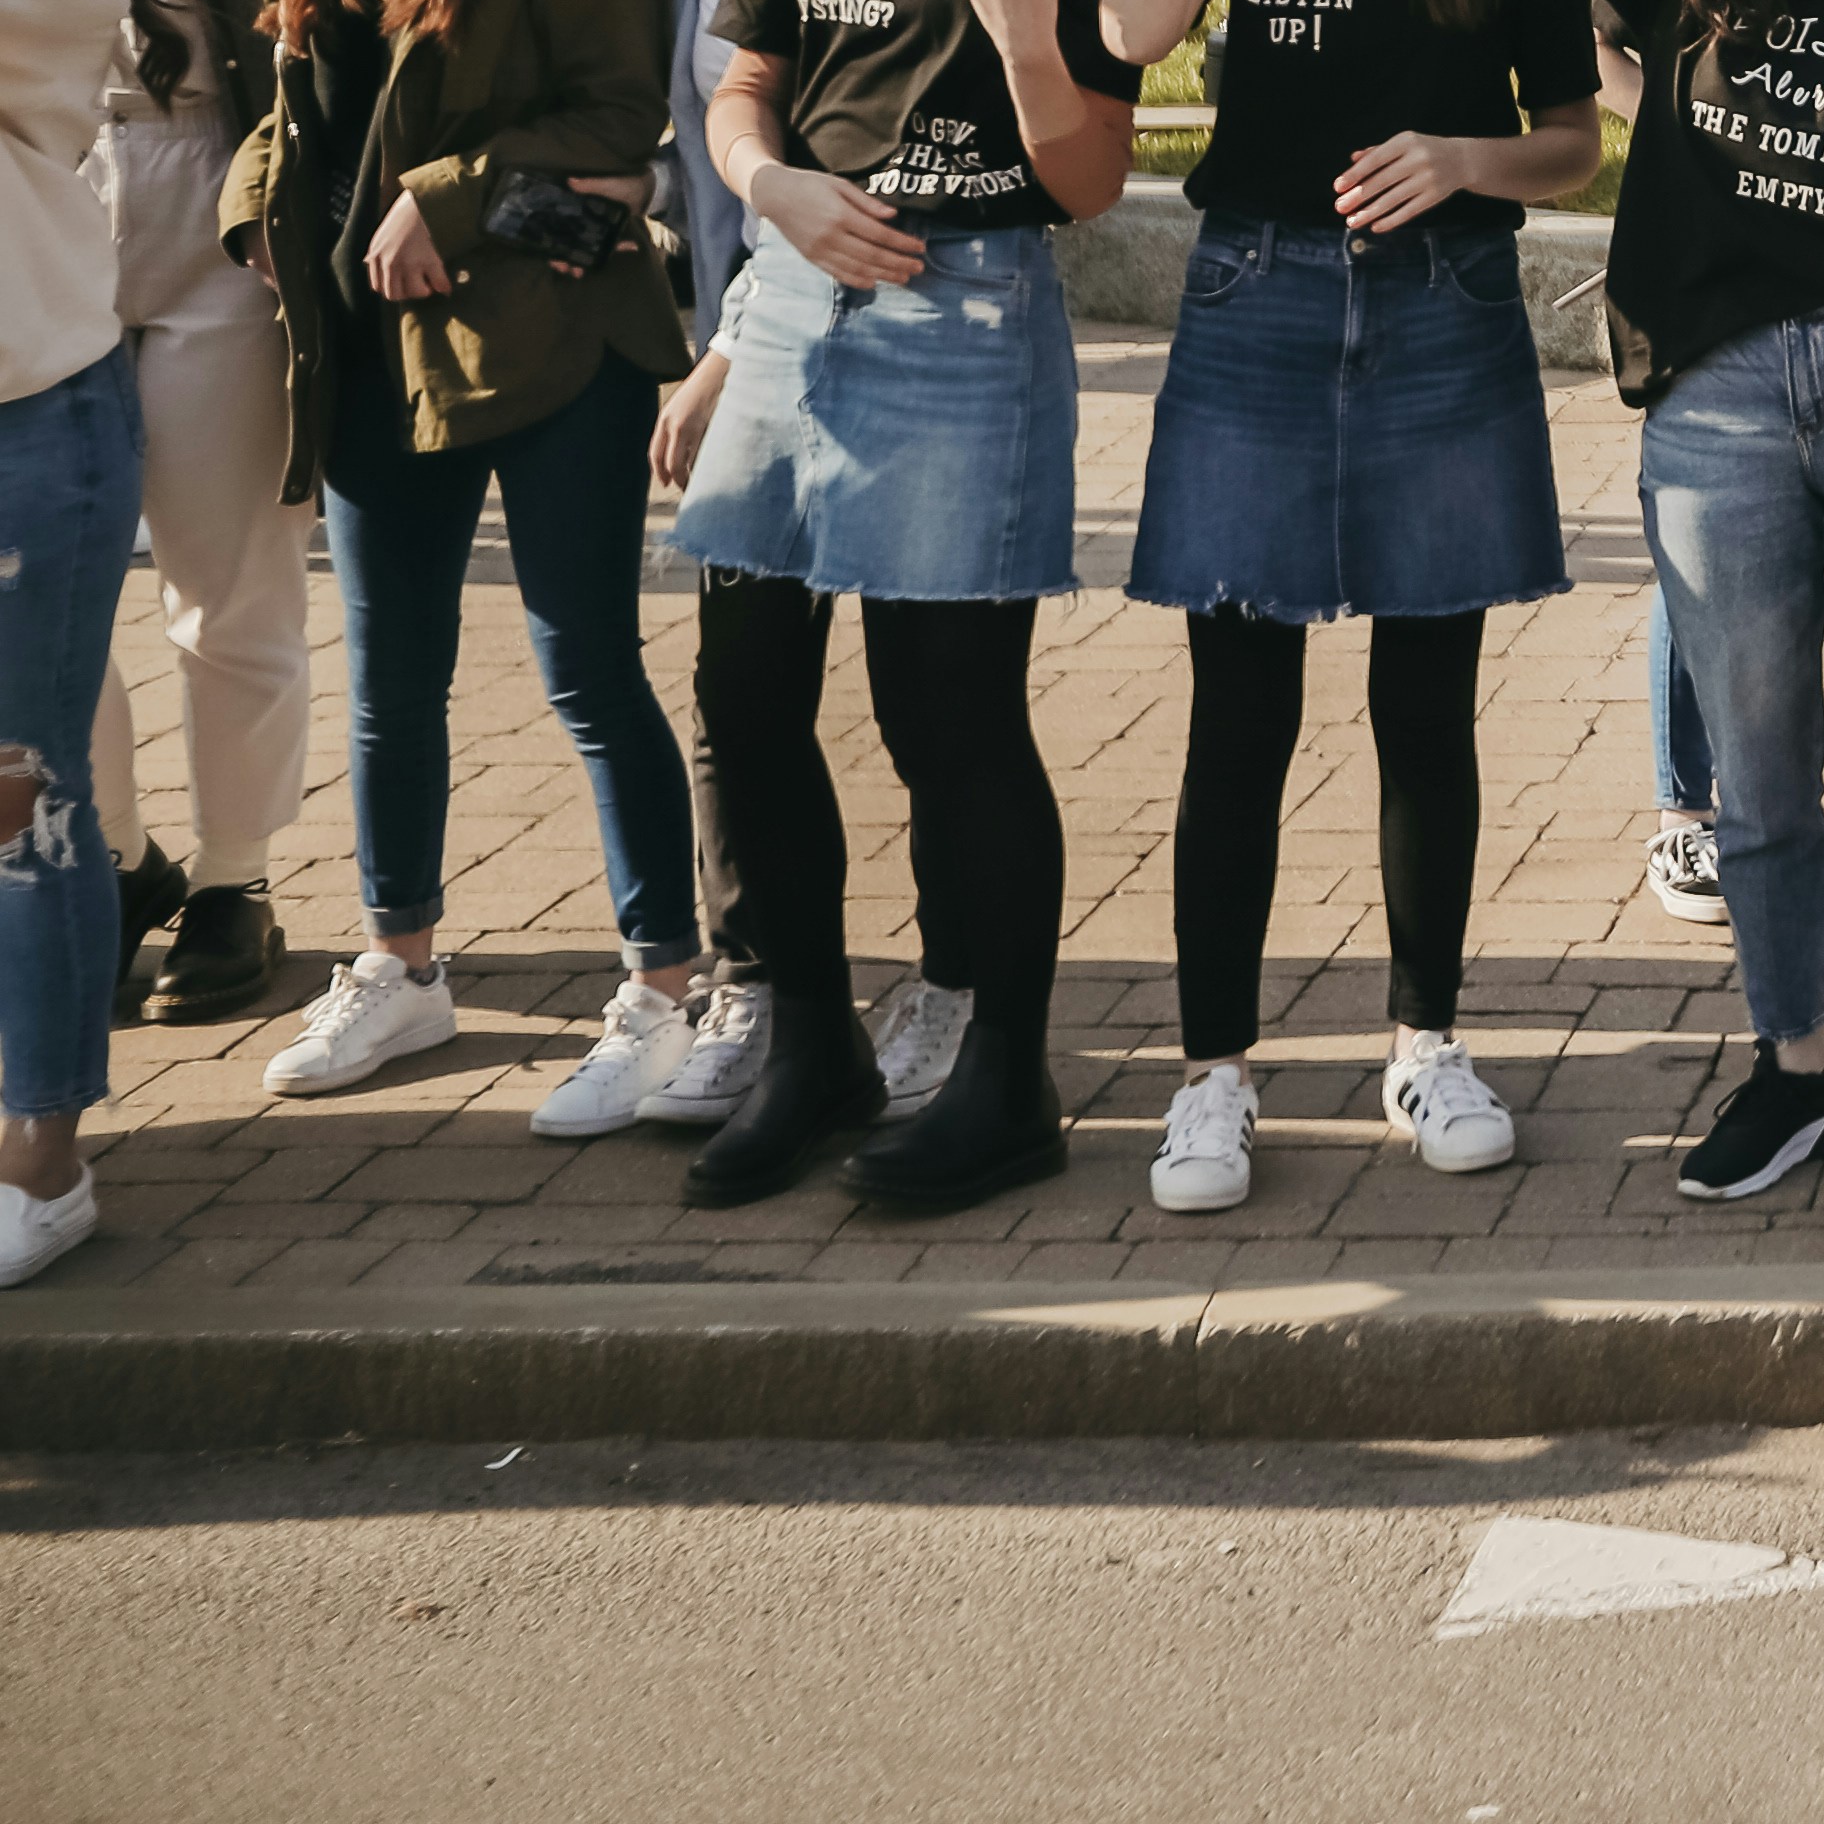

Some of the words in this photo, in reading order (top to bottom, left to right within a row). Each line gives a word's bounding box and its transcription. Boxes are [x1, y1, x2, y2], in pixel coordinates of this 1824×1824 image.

[1269, 14, 1322, 52] UP!
[1691, 100, 1748, 143] THE
[865, 168, 940, 195] YOUR
